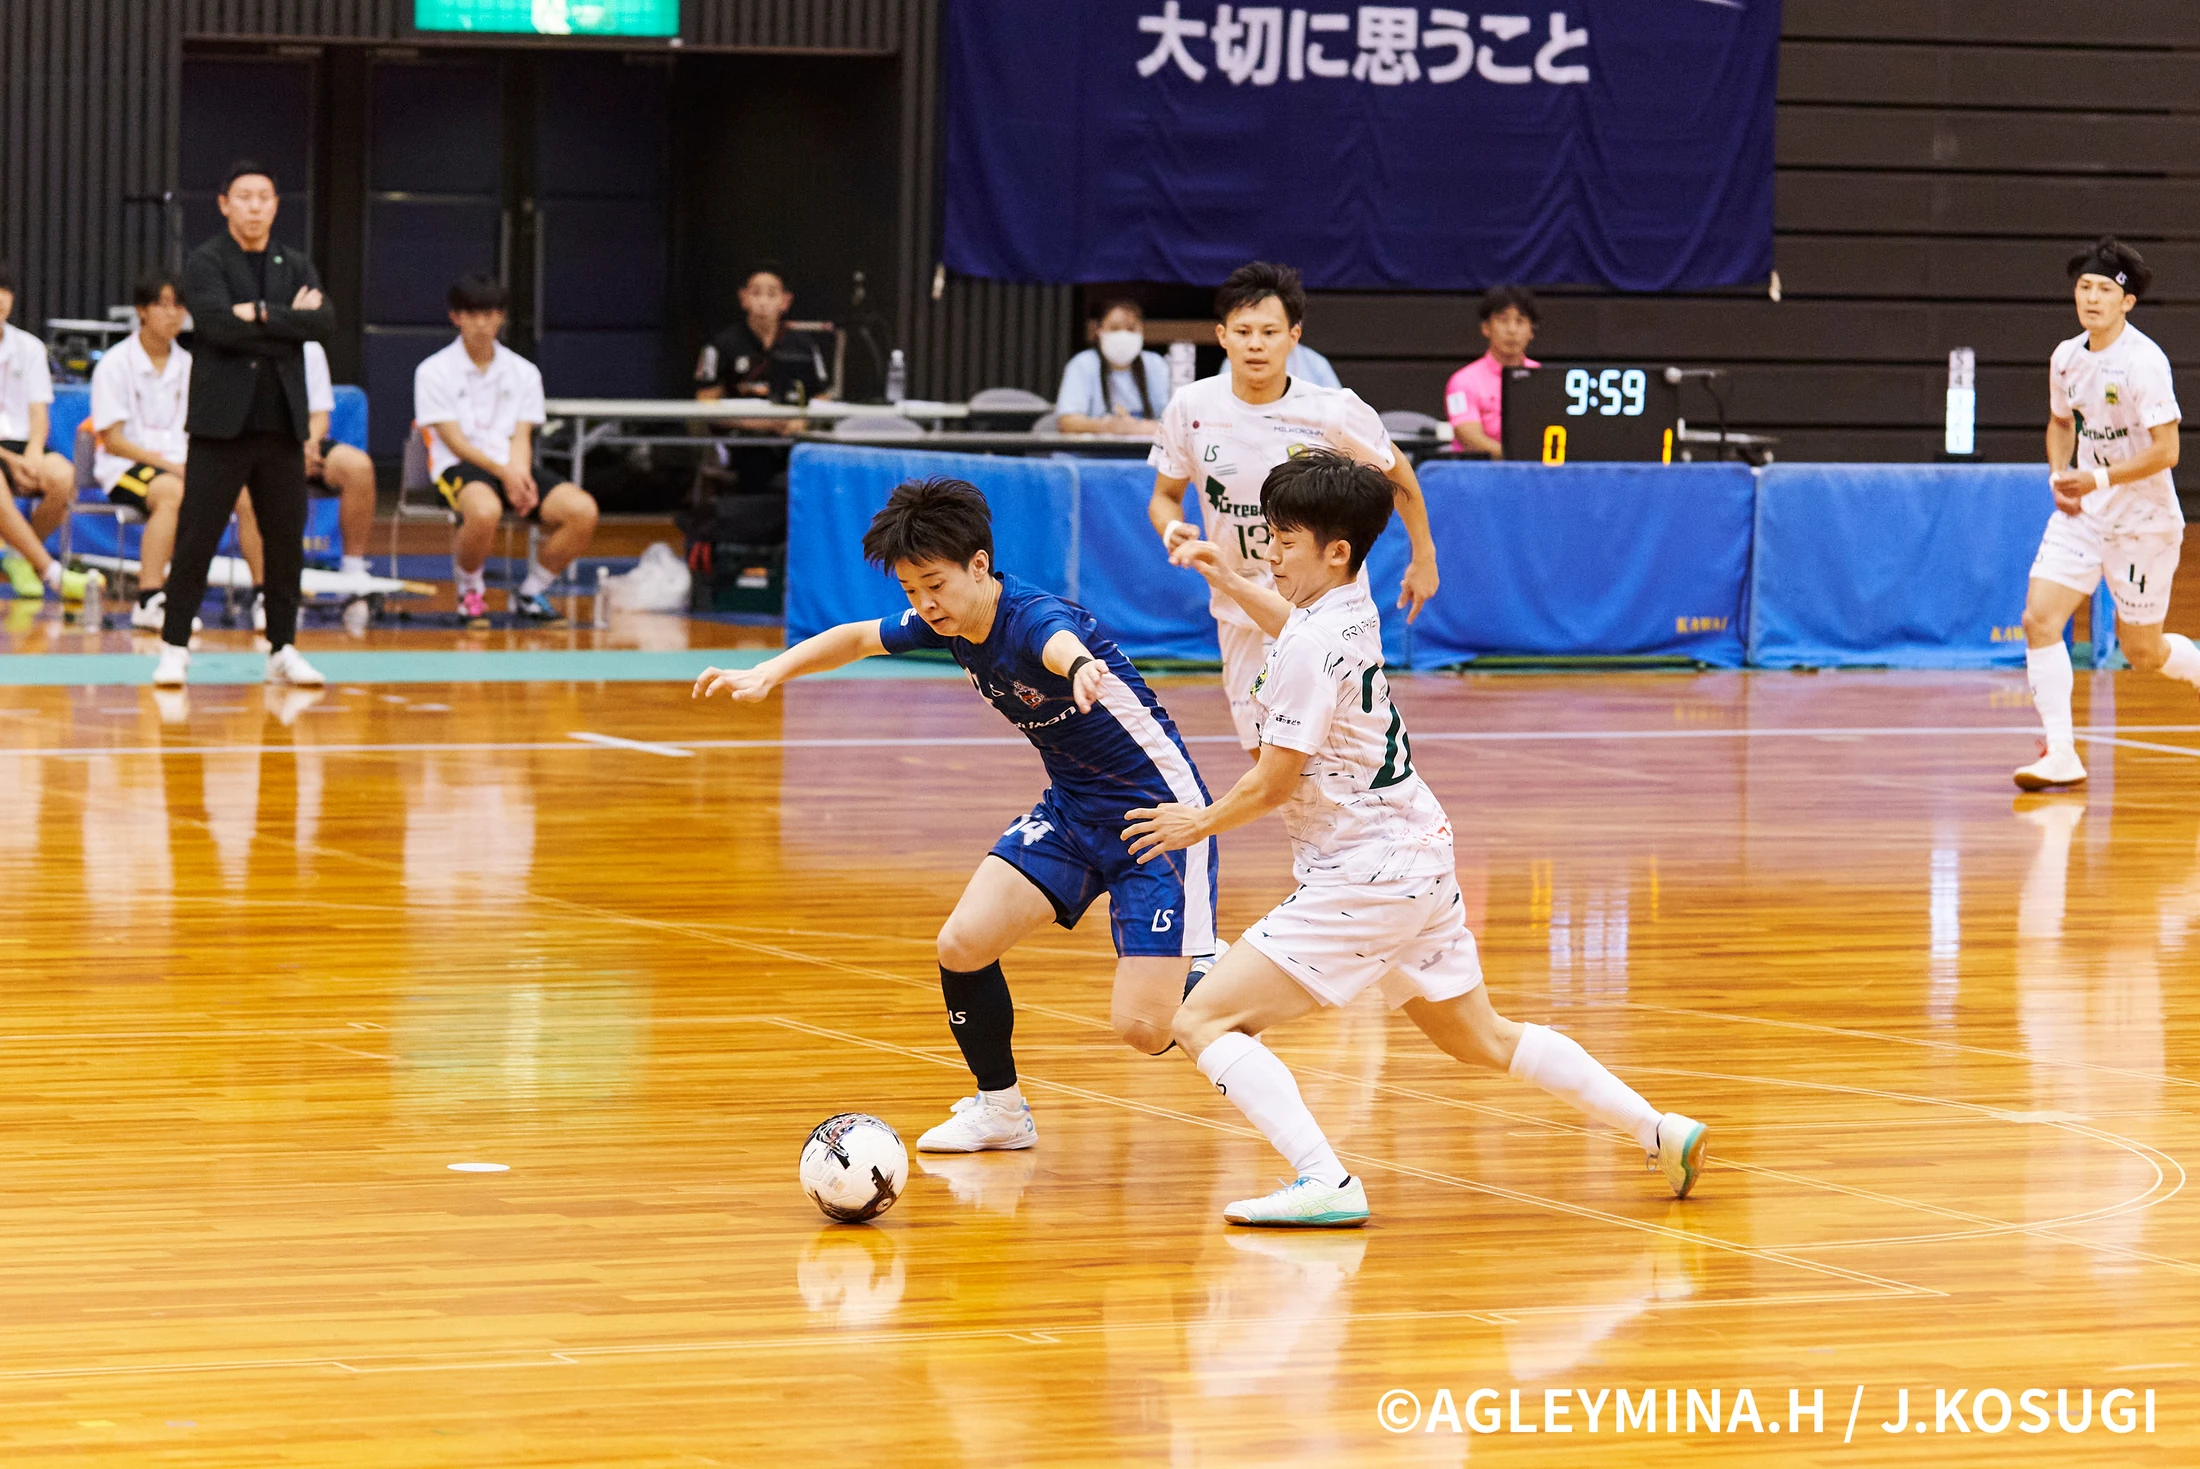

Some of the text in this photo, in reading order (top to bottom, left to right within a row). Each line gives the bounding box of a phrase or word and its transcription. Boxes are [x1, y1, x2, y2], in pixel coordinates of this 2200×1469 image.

[1136, 0, 1590, 86] 大切に思うこと
[1565, 368, 1646, 416] 9:59
[1203, 444, 1220, 462] LS
[1541, 424, 1567, 467] 0
[1661, 427, 1673, 466] 1
[1233, 523, 1270, 560] 13
[2130, 564, 2146, 594] 4
[1151, 909, 1175, 932] LS
[949, 1009, 967, 1025] LS
